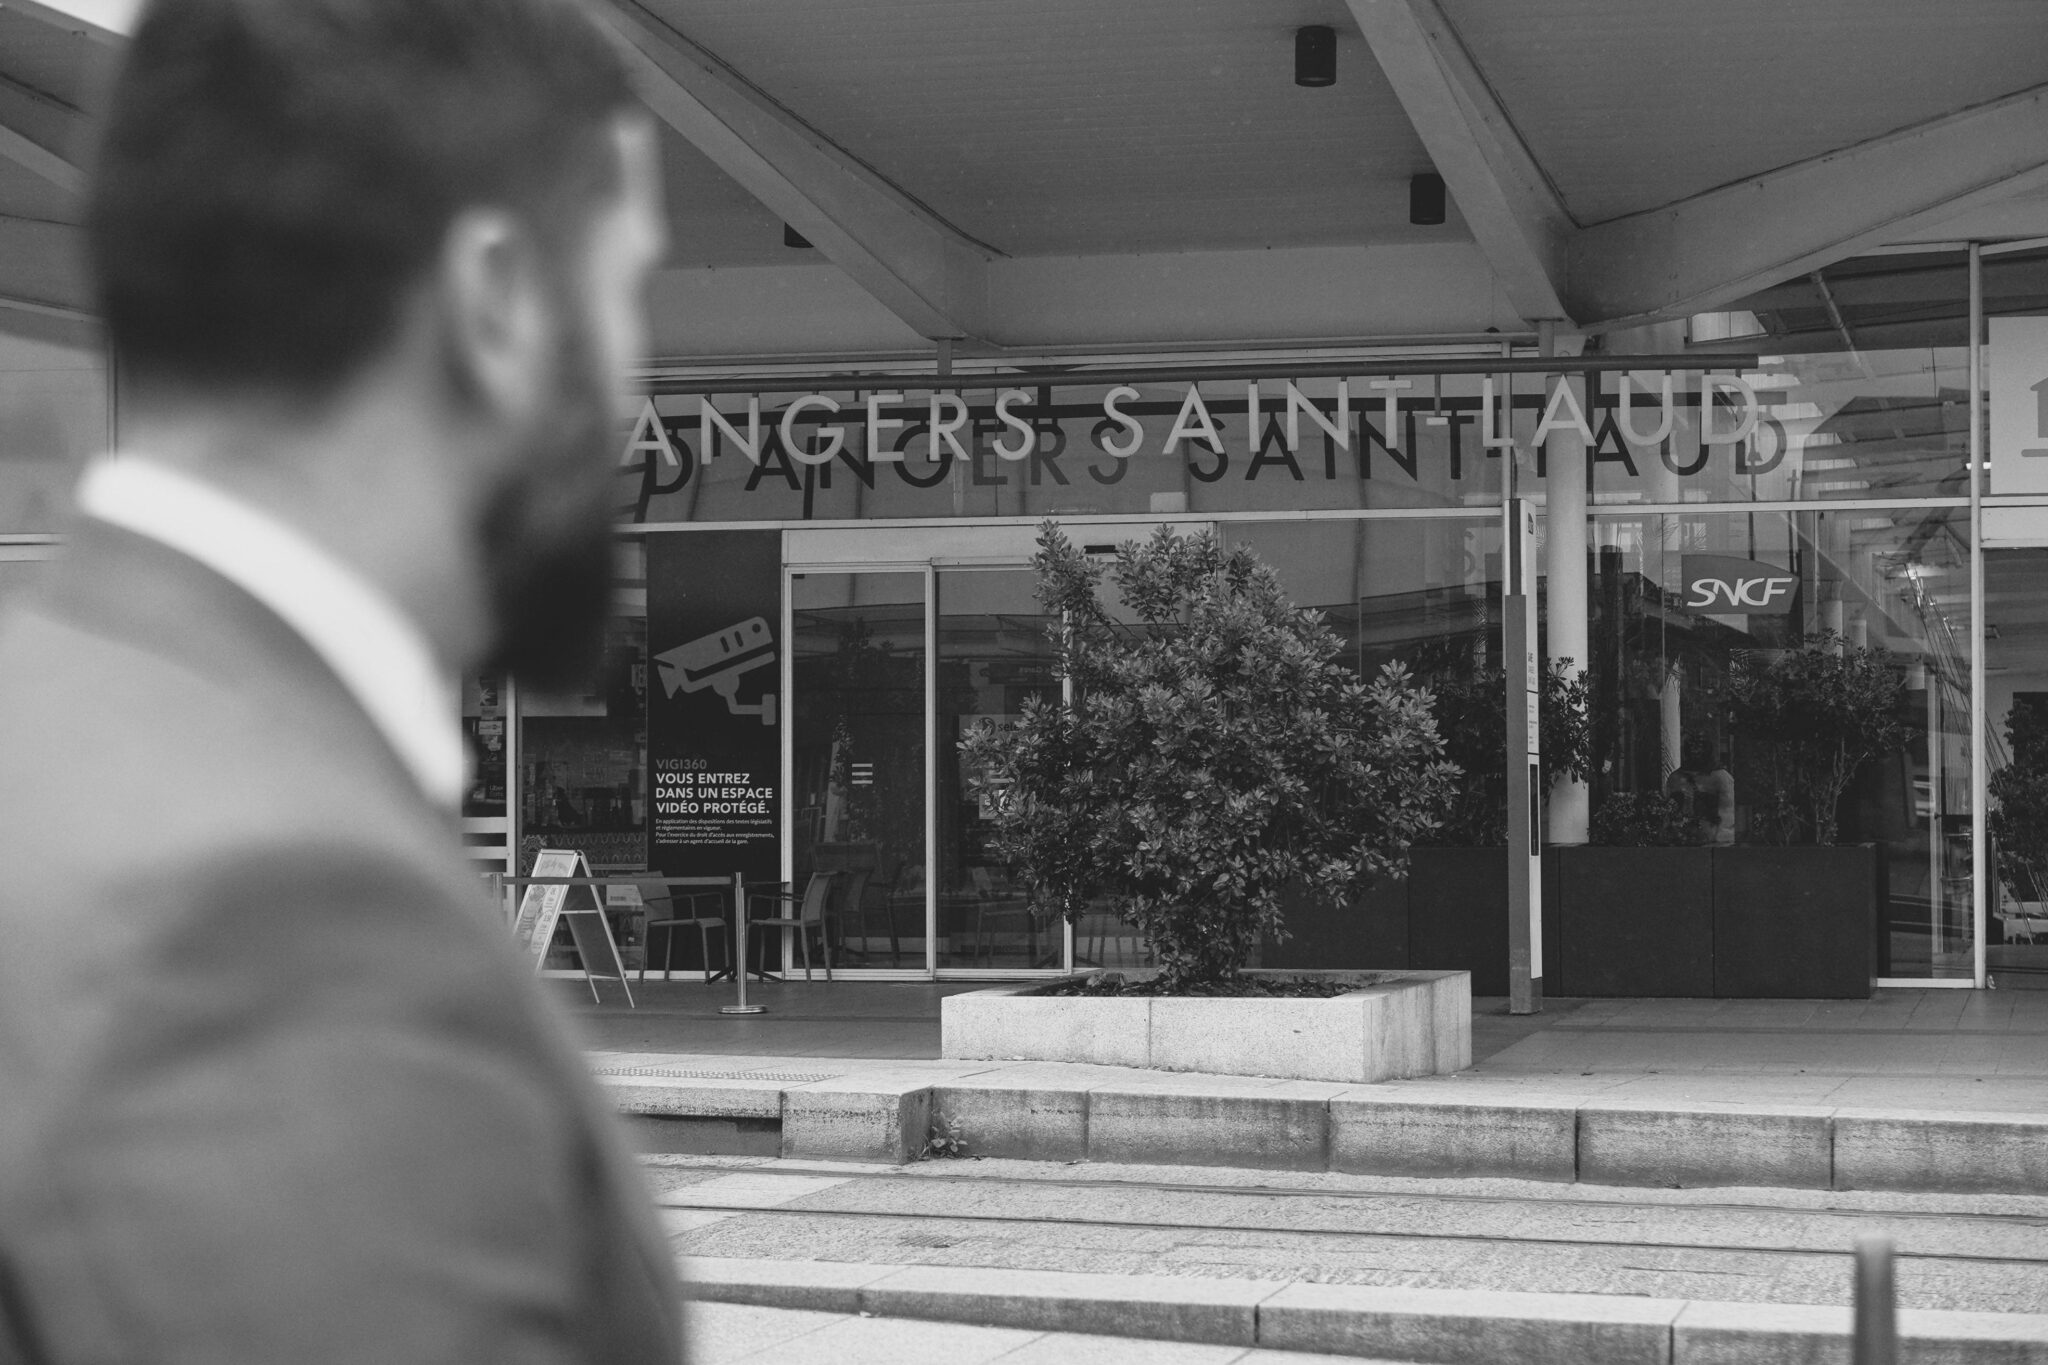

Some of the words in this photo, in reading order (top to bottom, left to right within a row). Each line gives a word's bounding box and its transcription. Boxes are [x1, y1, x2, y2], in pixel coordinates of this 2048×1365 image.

[1101, 374, 1759, 460] SAINT-LAUD
[1687, 577, 1793, 607] SNCF
[656, 759, 707, 770] VIGI360
[656, 773, 694, 784] VOUS
[698, 773, 750, 784] ENTREZ
[656, 787, 694, 799] DANS
[698, 787, 718, 799] UN
[721, 787, 773, 799] ESPACE
[656, 800, 699, 814] VIDÉO
[703, 800, 770, 814] PROTÉGÉ.
